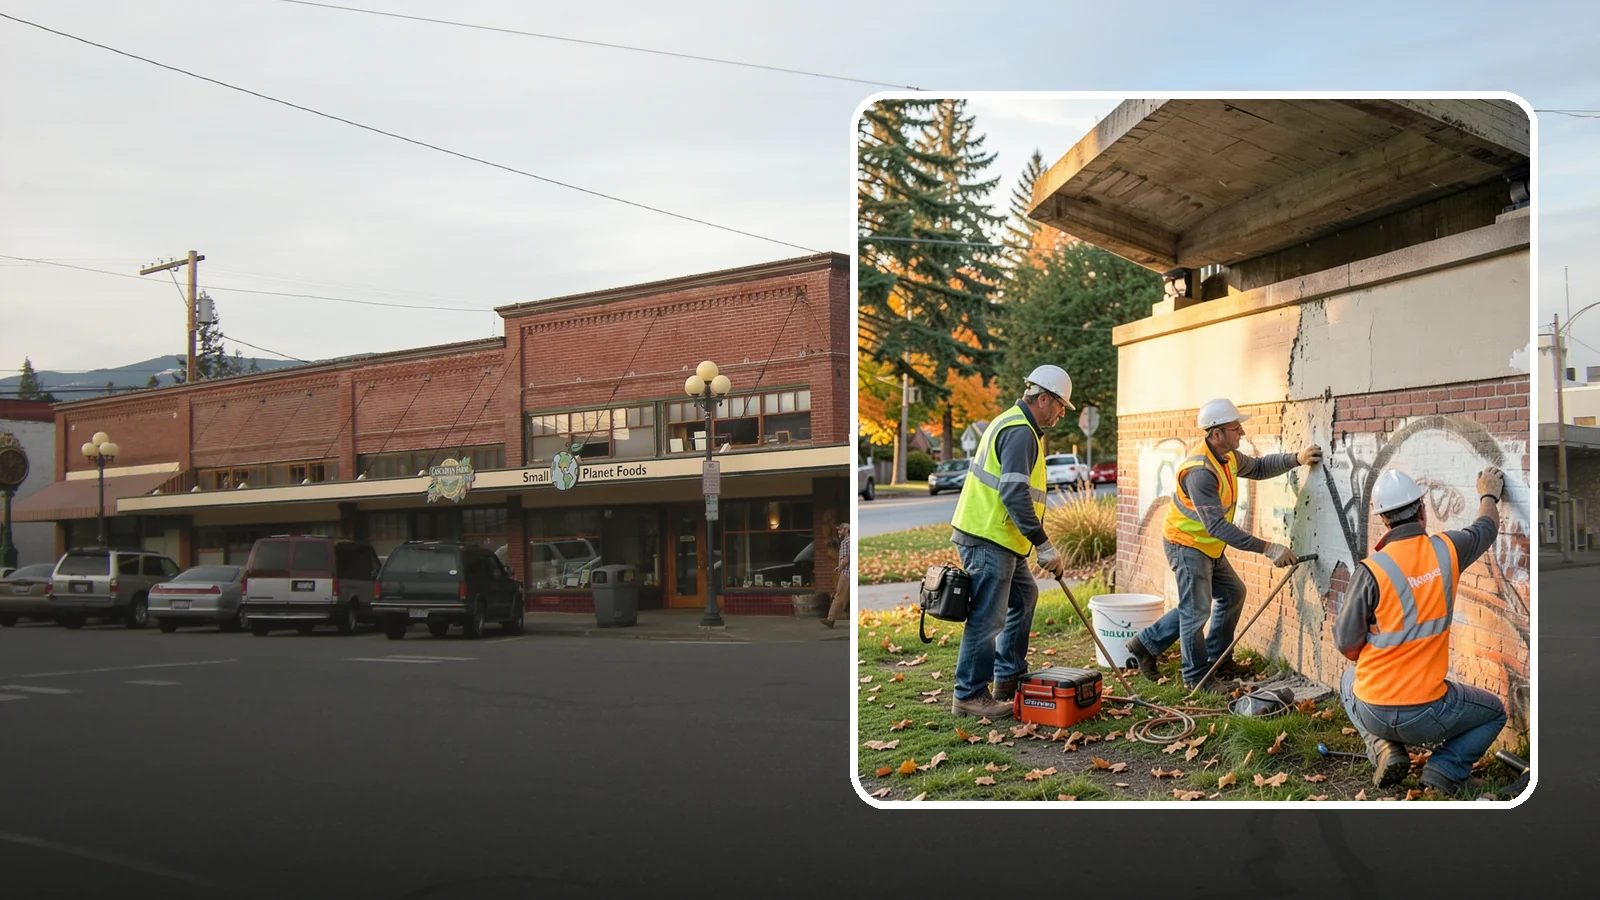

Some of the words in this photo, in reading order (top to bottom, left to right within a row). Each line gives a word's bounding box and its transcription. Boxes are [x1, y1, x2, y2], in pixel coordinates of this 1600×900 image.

[523, 471, 549, 483] Small
[582, 467, 614, 479] Planet
[616, 464, 647, 477] Foods
